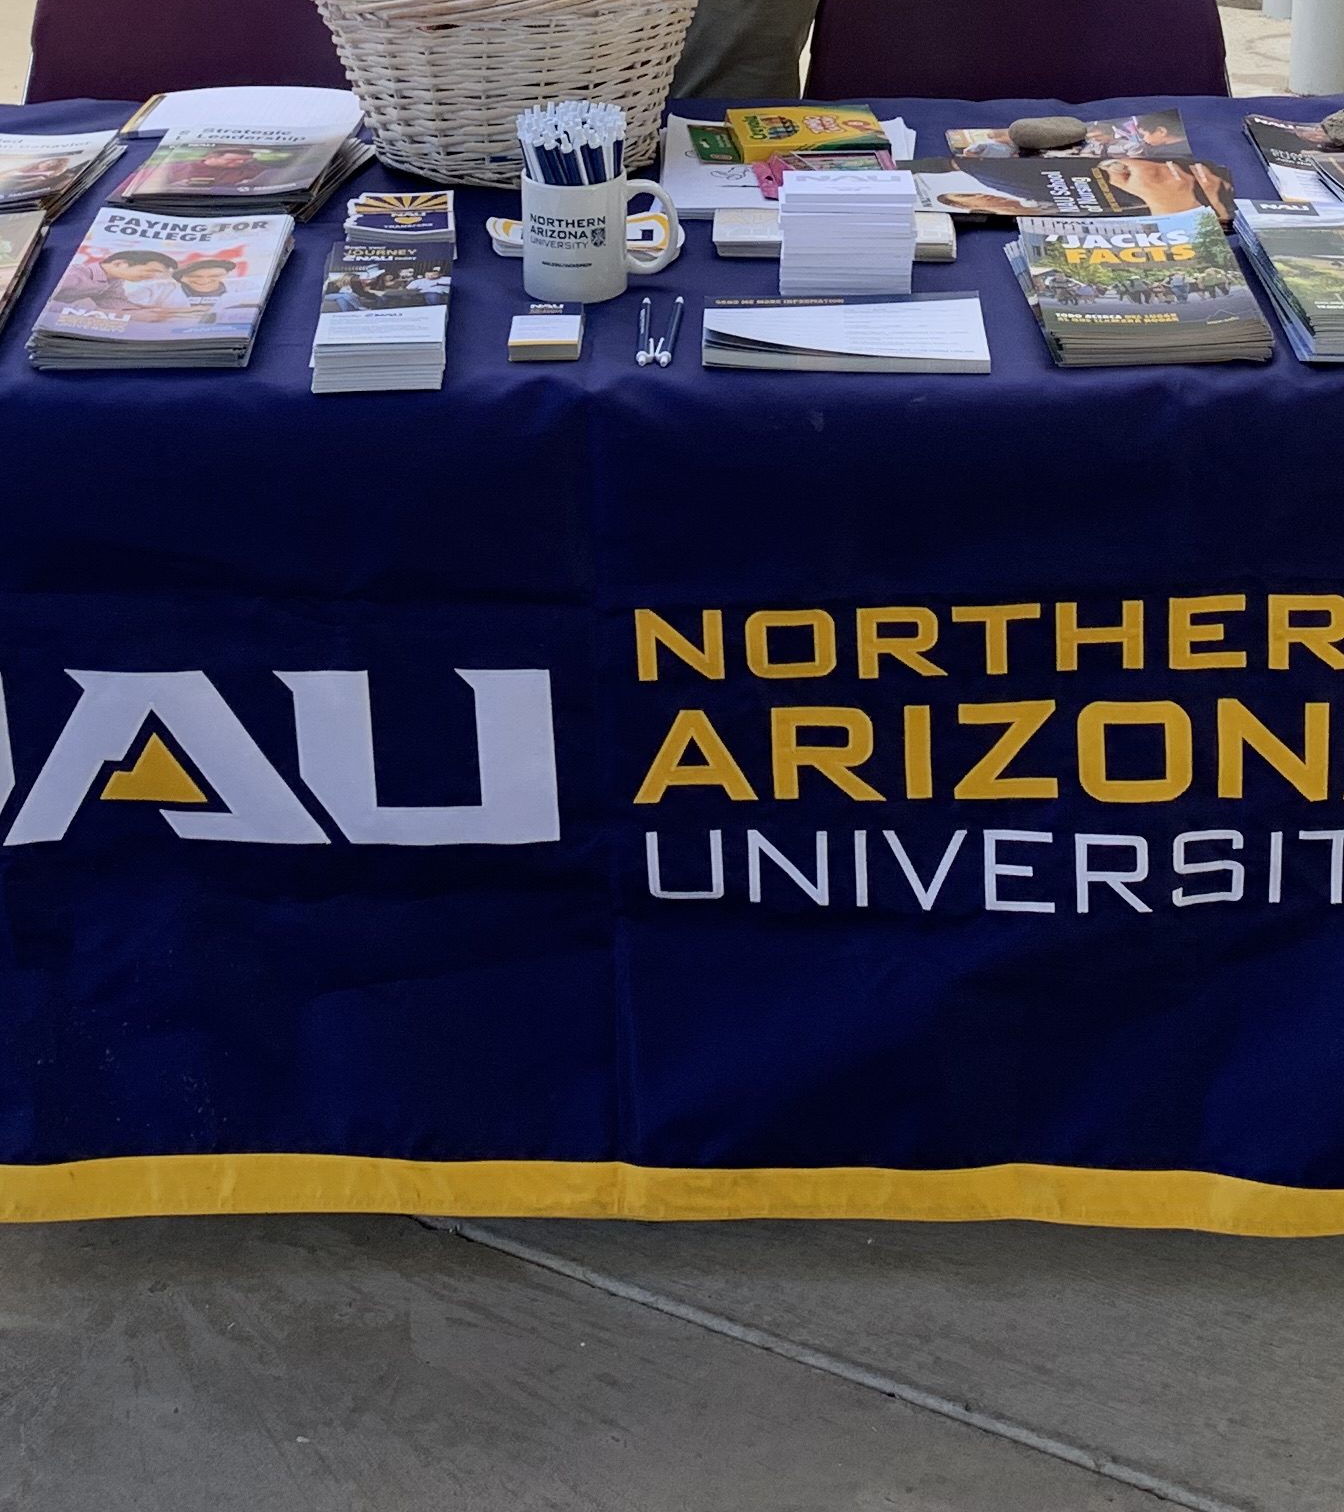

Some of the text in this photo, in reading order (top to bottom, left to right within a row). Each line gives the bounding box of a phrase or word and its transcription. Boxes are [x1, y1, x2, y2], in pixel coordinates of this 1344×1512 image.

[197, 134, 307, 143] Leadership
[203, 128, 291, 137] Strategic
[1040, 171, 1072, 196] School
[1259, 202, 1310, 211] NAU
[108, 215, 269, 233] PAYING FOR
[530, 213, 606, 227] NORTHERN
[104, 224, 212, 242] COLLEGE
[530, 226, 588, 239] ARIZONA
[530, 237, 589, 249] UNIVERSITY
[344, 249, 416, 257] JOURNEY
[1064, 244, 1196, 264] FACTS
[61, 307, 131, 322] NAU
